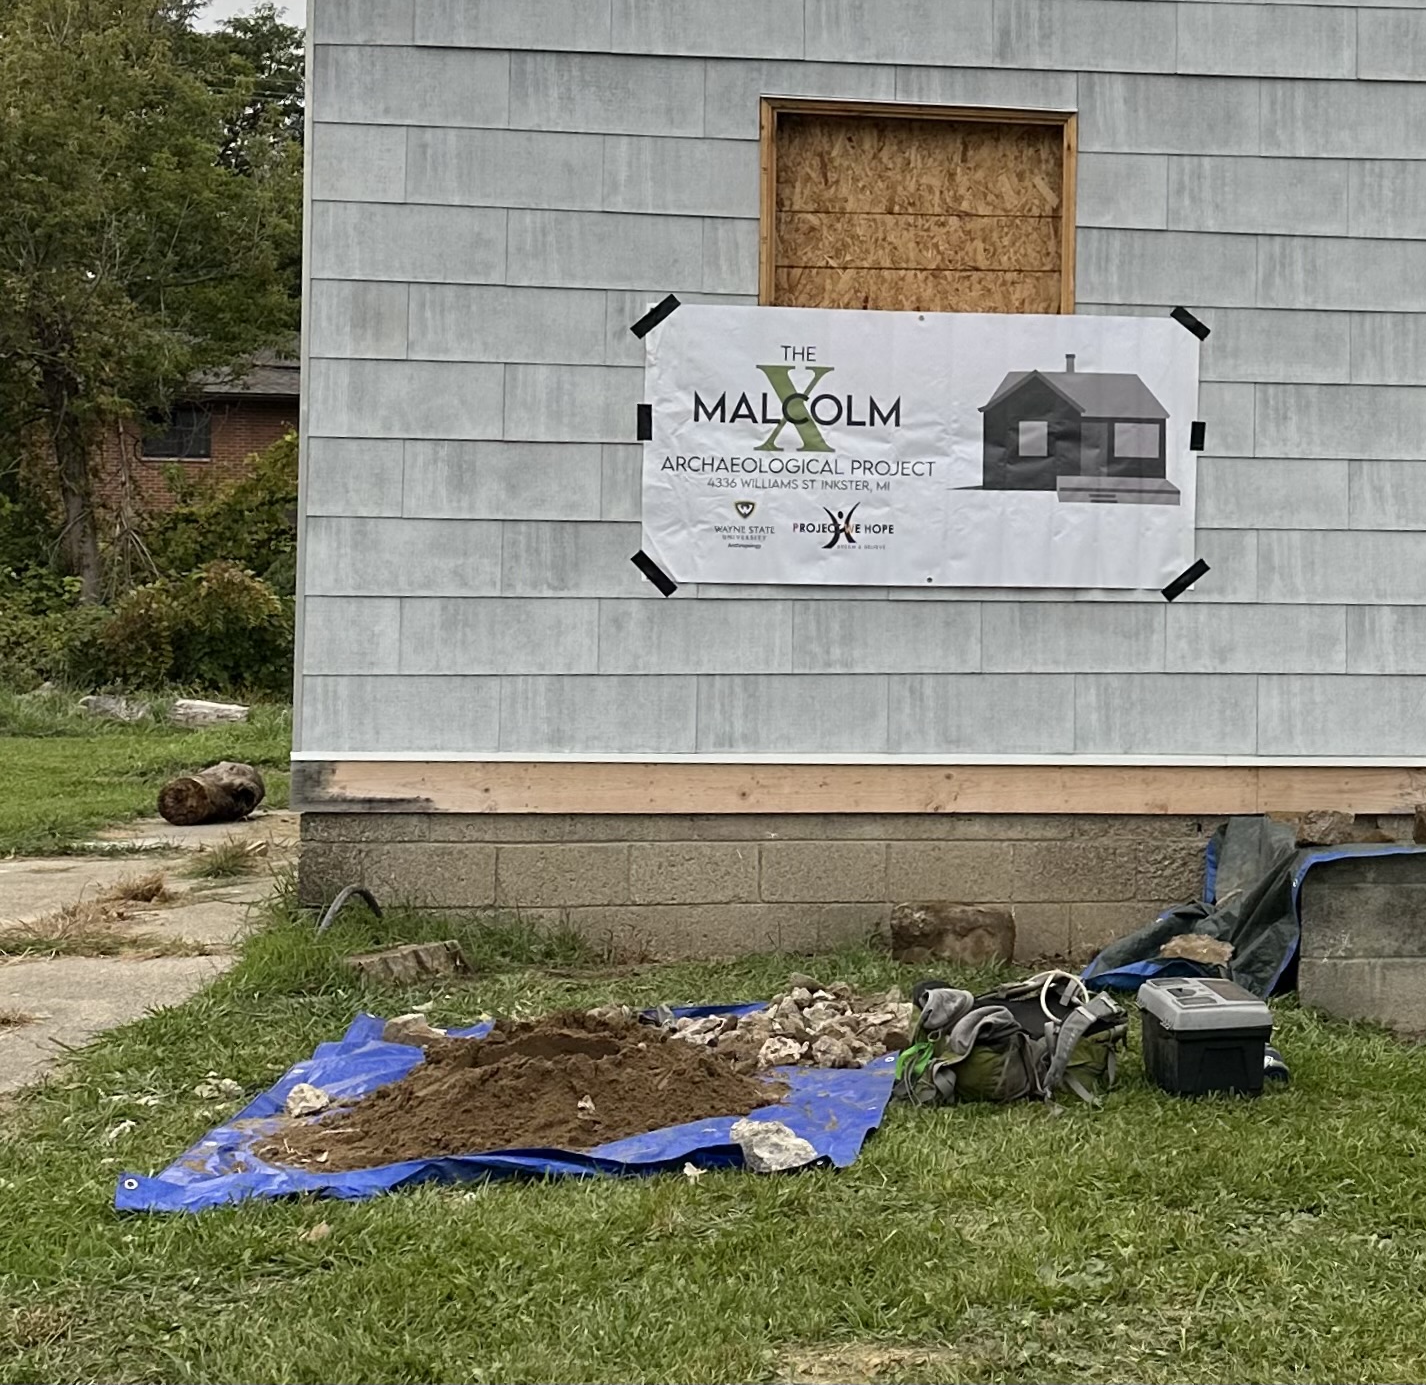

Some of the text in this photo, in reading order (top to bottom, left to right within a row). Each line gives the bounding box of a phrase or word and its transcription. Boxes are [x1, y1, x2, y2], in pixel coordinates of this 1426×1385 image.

[780, 345, 817, 362] THE
[693, 390, 901, 428] MALCOLM
[753, 364, 836, 453] X
[660, 456, 937, 477] ARCHAEOLOGICAL PROJECT
[707, 477, 891, 493] 4336 WILLIAMS ST INKSTER, MI
[714, 525, 775, 534] WAYNE STATE
[864, 524, 894, 534] HOPE
